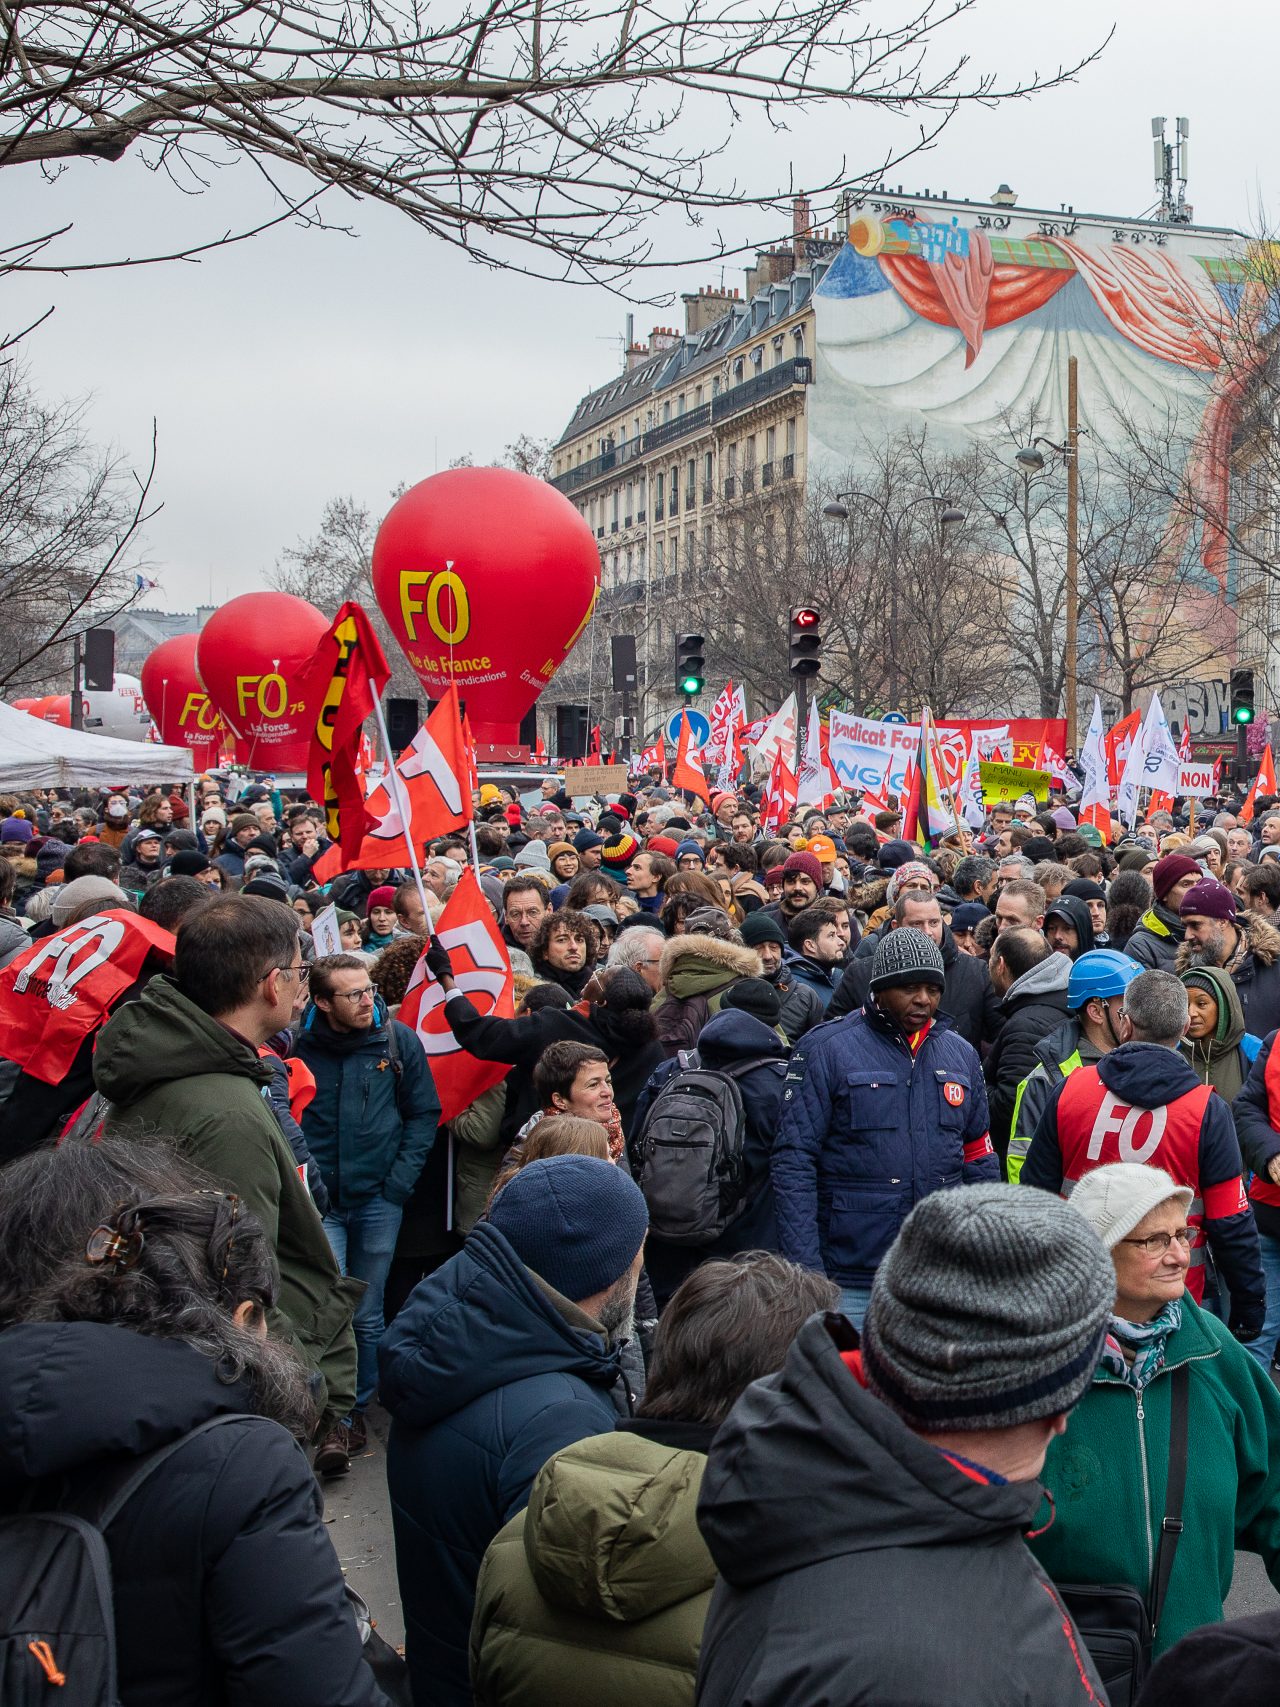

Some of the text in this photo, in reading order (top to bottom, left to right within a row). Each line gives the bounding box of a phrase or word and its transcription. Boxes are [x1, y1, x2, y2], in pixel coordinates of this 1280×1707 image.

[399, 569, 470, 645] FO
[423, 655, 438, 671] de
[439, 655, 492, 673] France
[236, 673, 306, 718] FO 75
[263, 723, 290, 733] Force
[1181, 772, 1210, 788] NON
[13, 915, 125, 993] FO
[949, 1085, 961, 1102] FO
[1086, 1090, 1168, 1164] FO
